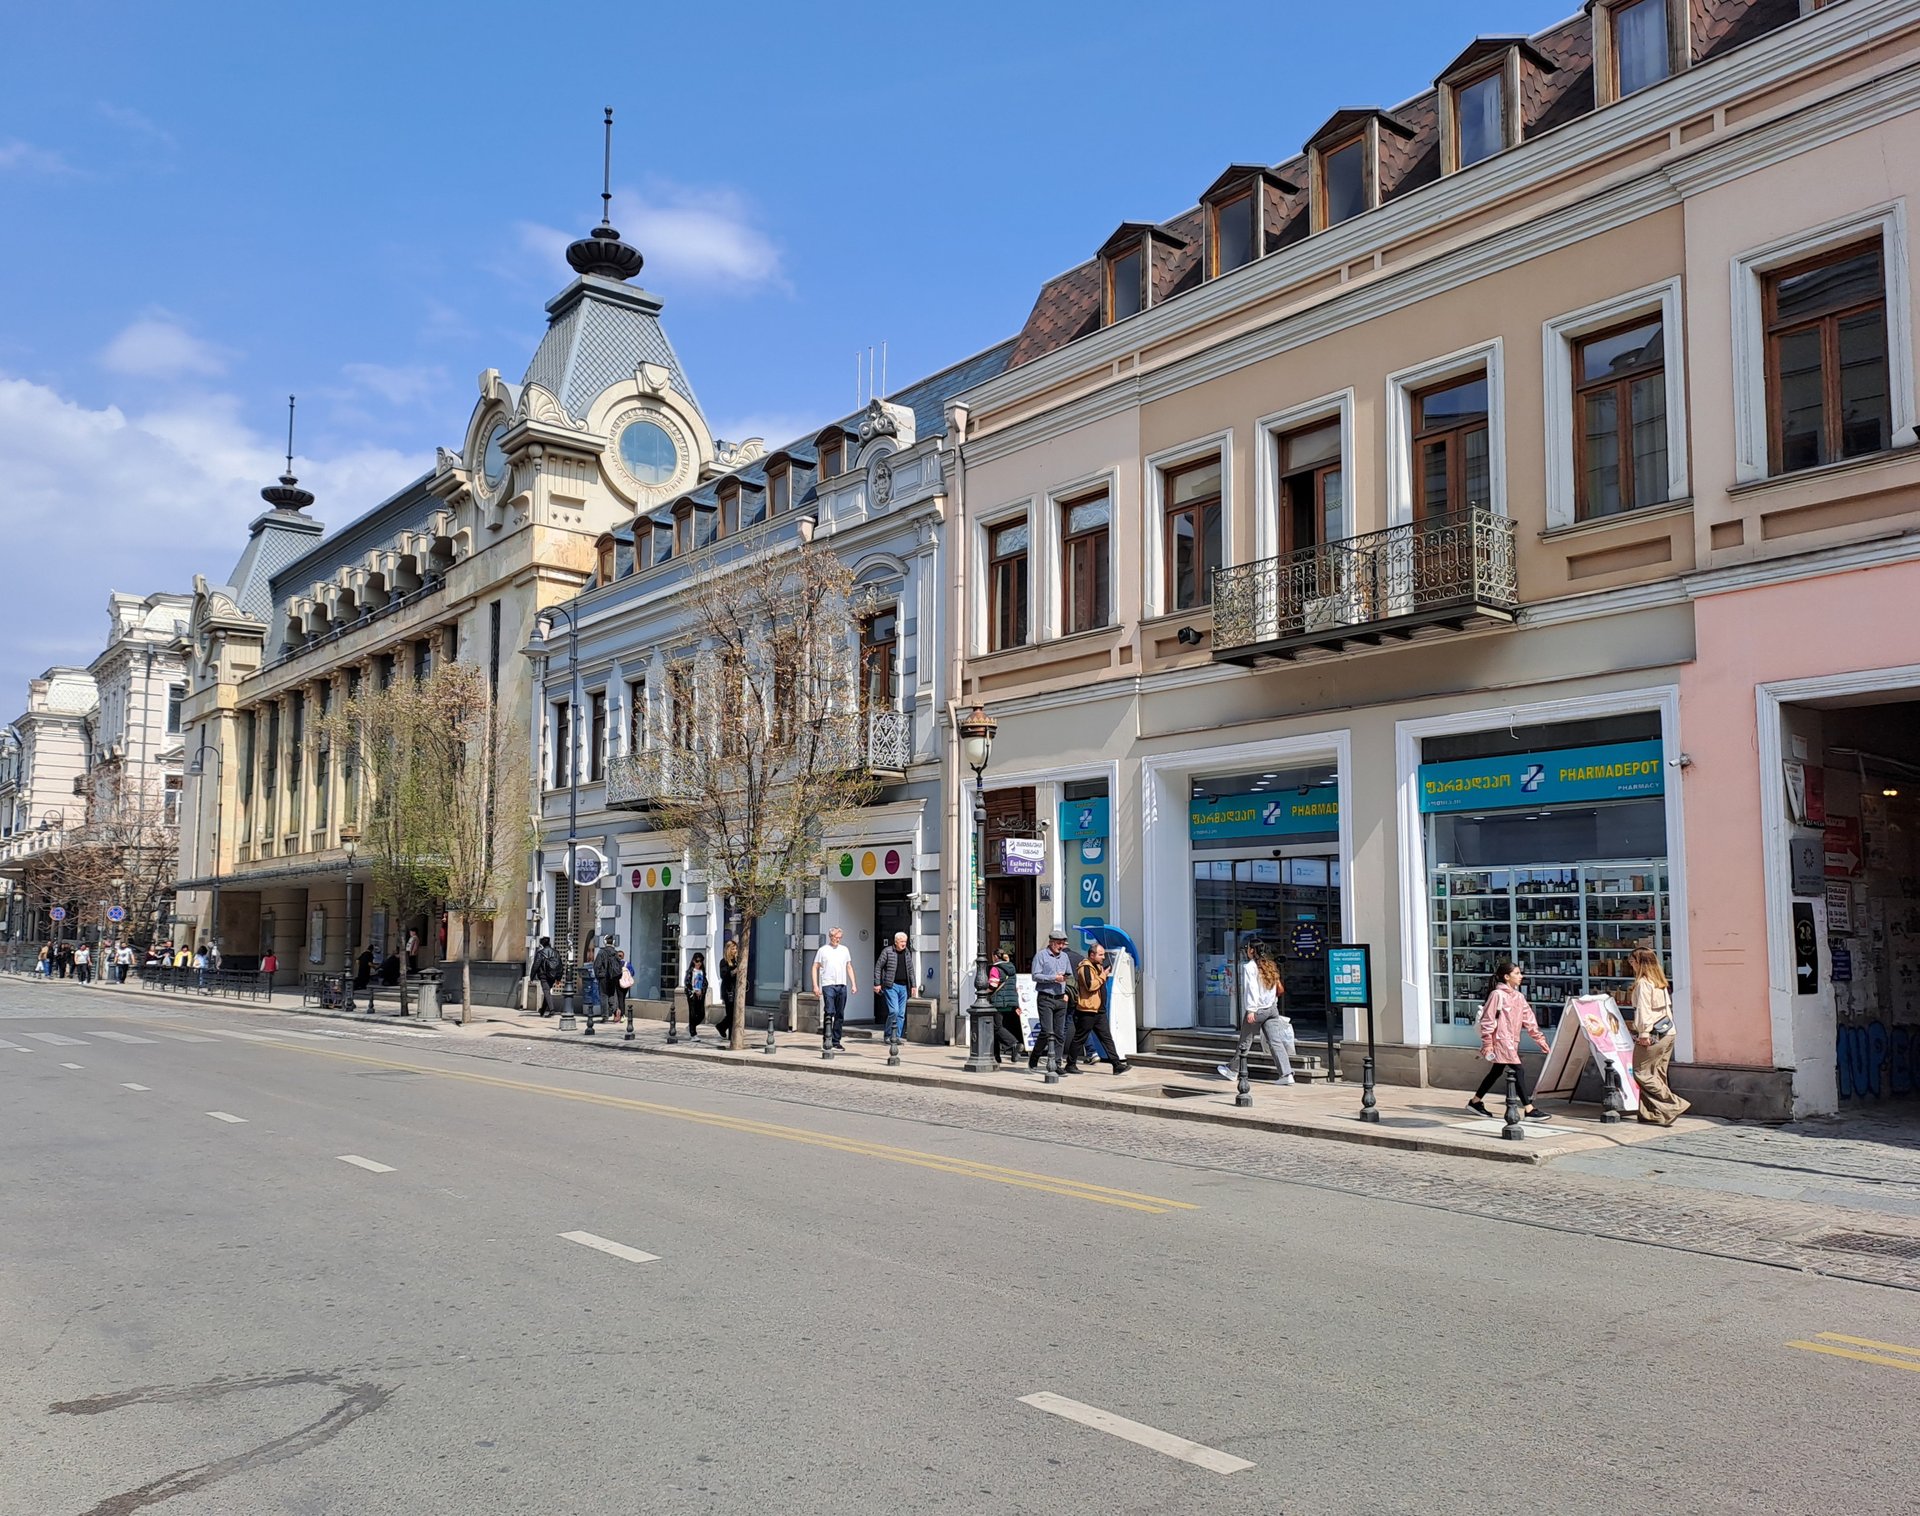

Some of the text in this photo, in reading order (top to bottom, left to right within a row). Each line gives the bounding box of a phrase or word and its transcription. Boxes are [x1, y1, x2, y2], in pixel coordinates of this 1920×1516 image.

[1559, 760, 1659, 782] PHARMADEPOT
[1617, 782, 1660, 790] PHARMACY
[1042, 887, 1050, 897] 97
